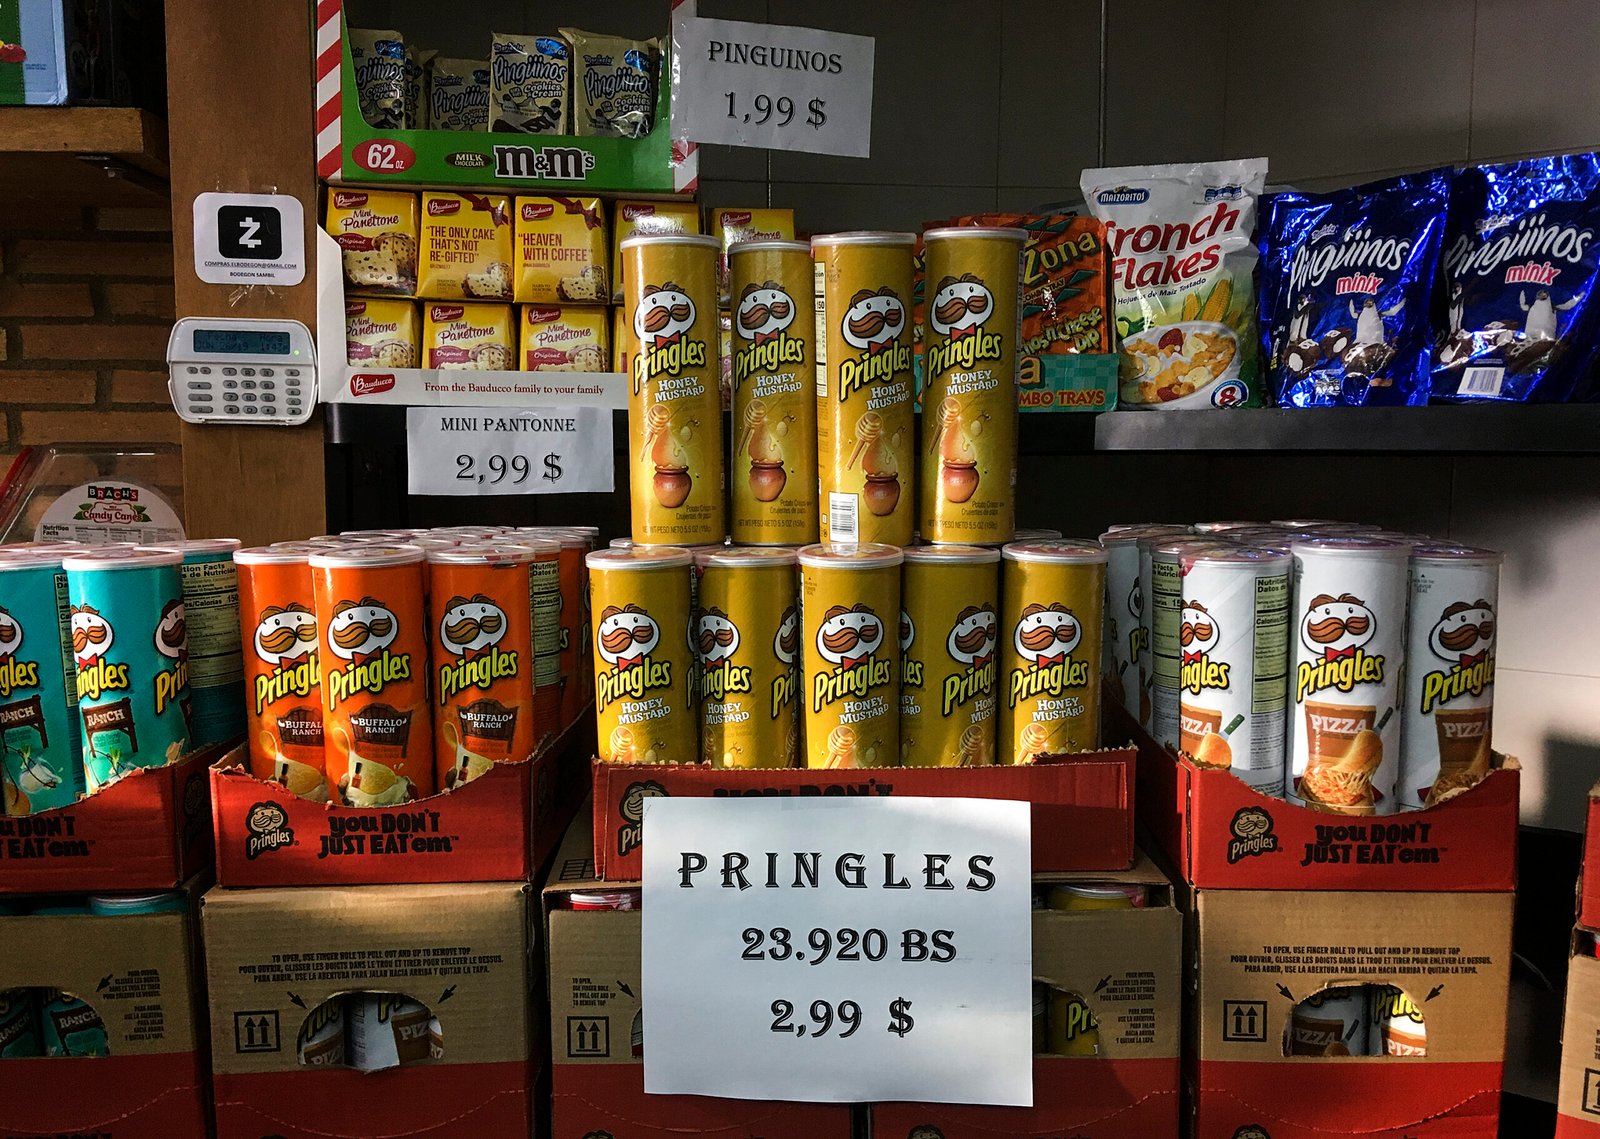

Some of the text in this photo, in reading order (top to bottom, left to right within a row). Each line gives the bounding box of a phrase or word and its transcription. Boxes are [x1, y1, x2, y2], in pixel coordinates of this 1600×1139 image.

[708, 40, 843, 74] PINGUINOS
[724, 91, 828, 130] 1,99 $
[367, 143, 395, 169] 62
[455, 153, 482, 161] MILK
[1100, 191, 1146, 203] MAIZORITOS
[352, 209, 372, 218] Mini
[340, 215, 400, 232] Panettone
[448, 226, 471, 239] ONLY
[472, 228, 495, 241] CAKE
[430, 238, 480, 252] THAT'S NOT
[523, 247, 550, 261] WITH
[1504, 260, 1562, 286] minix
[1335, 271, 1384, 296] minix
[438, 326, 495, 344] Panettone
[450, 321, 467, 332] Mini
[547, 323, 565, 332] Mini
[535, 328, 592, 346] Panettone
[633, 335, 706, 396] Pringles
[736, 332, 804, 391] Pringles
[927, 328, 1002, 387] Pringles
[756, 373, 796, 387] HONEY
[839, 341, 911, 402] Pringles
[950, 369, 993, 385] HONEY
[352, 376, 393, 394] Bauducco
[424, 382, 604, 396] From the Bauducco family to your family
[657, 376, 699, 392] HONEY
[752, 381, 803, 399] MUSTARD
[870, 382, 907, 399] HONEY
[946, 378, 999, 396] MUSTARD
[654, 385, 705, 403] MUSTARD
[866, 390, 911, 411] MUSTARD
[440, 417, 576, 432] MINI PANTONNE
[455, 452, 564, 484] 2,99 $
[88, 487, 138, 500] BRACH'S
[83, 510, 113, 521] Candy
[328, 650, 410, 712] Pringles
[440, 646, 518, 705] Pringles
[814, 655, 890, 713] Pringles
[1010, 653, 1088, 709] Pringles
[1296, 648, 1384, 704] Pringles
[598, 657, 671, 713] Pringles
[621, 698, 664, 714] HONEY
[706, 702, 742, 714] HONEY
[843, 695, 885, 714] HONEY
[1032, 704, 1085, 722] MUSTARD
[1036, 696, 1080, 714] HONEY
[86, 709, 126, 727] RANCH
[358, 717, 404, 727] BUFFALO
[467, 712, 509, 722] BUFFALO
[617, 706, 671, 725] MUSTARD
[705, 712, 750, 725] MUSTARD
[839, 703, 889, 725] MUSTARD
[1310, 713, 1367, 733] PIZZA
[292, 728, 322, 736] RANCH
[365, 726, 396, 734] RANCH
[473, 721, 502, 729] RANCH
[380, 809, 441, 833] DON'T
[1370, 820, 1432, 844] DON'T
[251, 829, 291, 854] Pringles
[317, 835, 366, 860] JUST
[1231, 837, 1275, 861] Pringles
[1300, 843, 1352, 867] JUST
[677, 851, 996, 892] PRINGLES
[741, 926, 957, 966] 23.920 BS
[1273, 946, 1291, 954] OPEN,
[1292, 946, 1305, 954] USE
[1422, 947, 1446, 955] REMOVE
[1448, 947, 1460, 955] TOP
[1248, 955, 1273, 964] OUVRIR,
[1275, 955, 1300, 963] GLISSER
[1393, 956, 1411, 964] TIRER
[1412, 956, 1428, 964] POUR
[1430, 956, 1457, 964] ENLEVER
[1245, 965, 1261, 973] PARA
[1262, 965, 1283, 974] ABRIR,
[1285, 965, 1297, 973] USE
[1398, 966, 1420, 974] ARRIBA
[1422, 966, 1426, 974] Y
[1428, 966, 1450, 975] QUITAR
[770, 996, 915, 1038] 2,99 $
